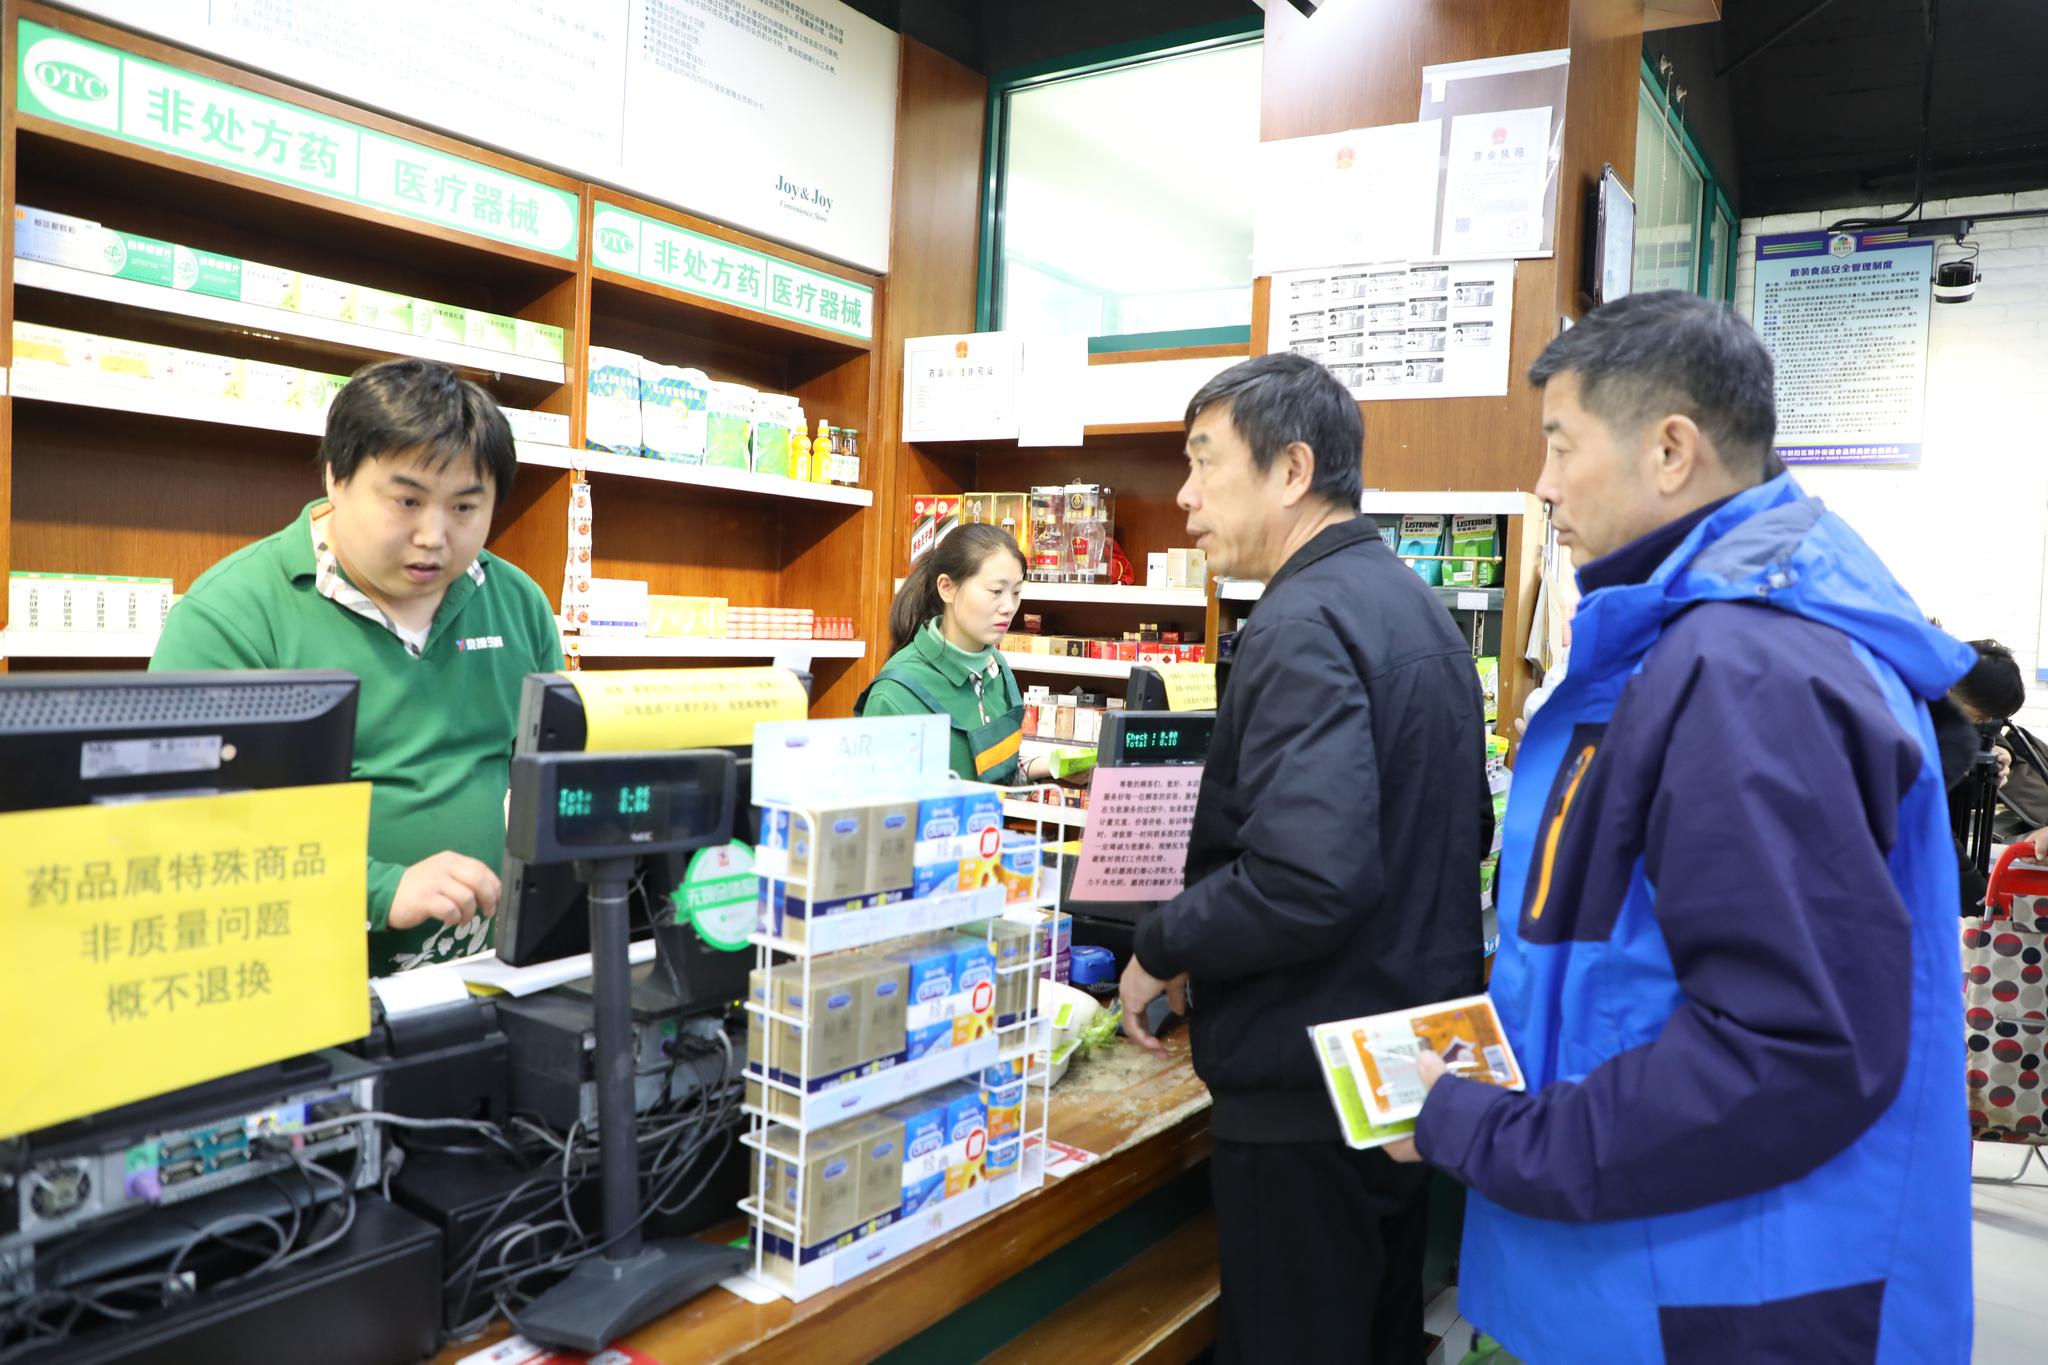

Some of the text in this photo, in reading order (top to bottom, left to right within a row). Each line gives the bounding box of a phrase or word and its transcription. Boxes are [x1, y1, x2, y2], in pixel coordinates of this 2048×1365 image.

[38, 63, 107, 101] OTC
[146, 86, 339, 180] 非处方药
[394, 158, 539, 236] 医疗器械
[598, 228, 633, 253] OTC
[654, 240, 760, 299] 非处方药
[1790, 260, 1893, 277] 散装食品安全管理制度
[773, 273, 861, 328] 医疗器械
[1405, 521, 1440, 529] LISTERINE
[1456, 518, 1493, 528] LISTERINE
[1125, 739, 1147, 748] Total
[1126, 731, 1148, 740] Check
[25, 842, 325, 909] 药品属特殊商品
[81, 900, 291, 963] 非质量问题
[106, 961, 271, 1025] 概不退换
